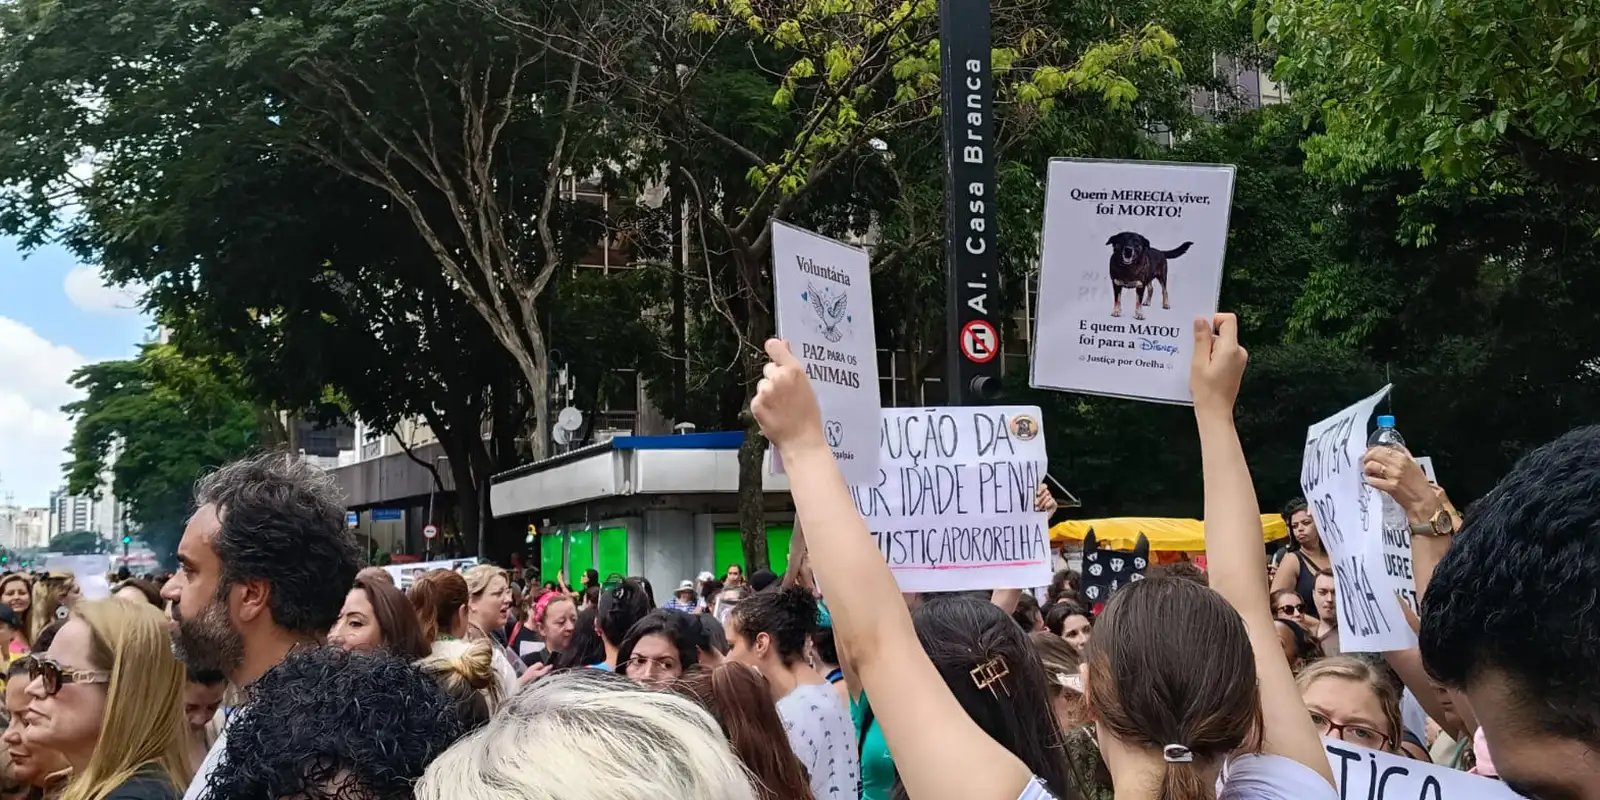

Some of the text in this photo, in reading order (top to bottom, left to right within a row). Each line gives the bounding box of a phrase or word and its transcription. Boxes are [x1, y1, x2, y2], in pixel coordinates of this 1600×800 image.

[963, 58, 988, 315] Al. Casa Branca
[1070, 188, 1211, 206] Quem MERECIA viver,
[1096, 202, 1183, 218] foi MORTO!
[796, 255, 851, 287] Voluntária
[1079, 319, 1181, 339] E quem MATOU
[1079, 334, 1095, 346] foi
[1097, 338, 1125, 349] para
[1128, 340, 1136, 349] a
[802, 343, 858, 366] PAZ PARA OS
[1086, 354, 1165, 369] Justiça por Orelha
[806, 363, 860, 389] ANIMAIS
[974, 413, 1015, 456] DA
[900, 464, 968, 516] IDADE
[979, 461, 1046, 514] PENAL
